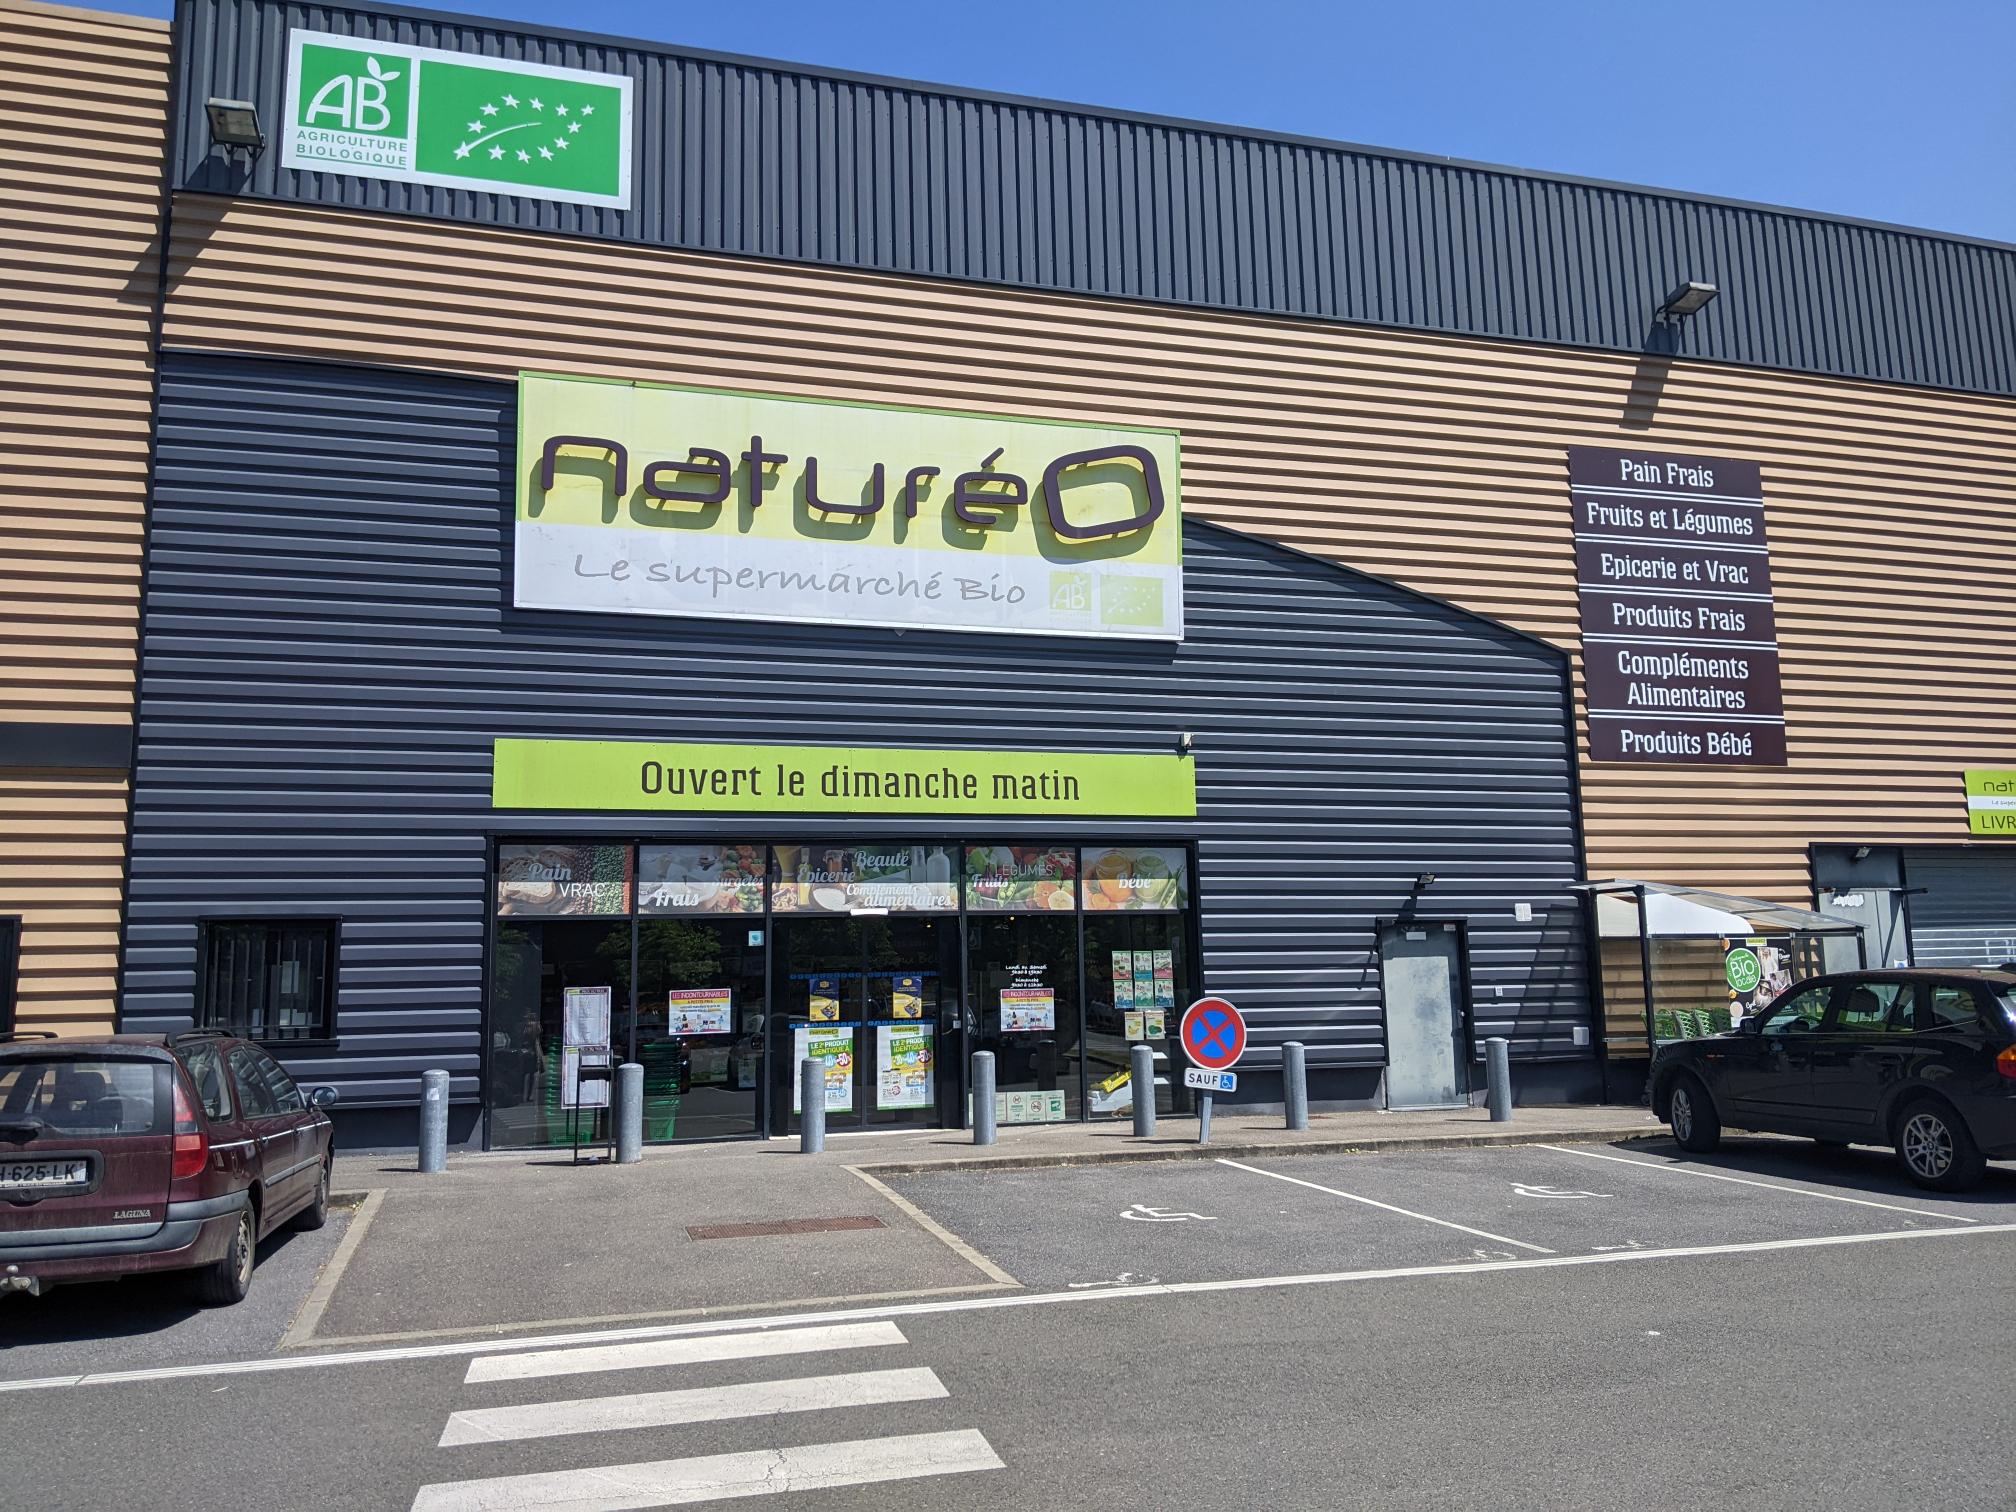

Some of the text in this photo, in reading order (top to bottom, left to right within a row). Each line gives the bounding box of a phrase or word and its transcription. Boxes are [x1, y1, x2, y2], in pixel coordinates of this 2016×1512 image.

[305, 74, 391, 131] AB
[296, 143, 407, 166] BIOLOGIQUE
[297, 130, 408, 152] AGRICULTURE
[1620, 458, 1714, 488] Pain Frais
[541, 435, 1165, 540] naturéO
[1587, 501, 1753, 536] Fruits et Légumes
[574, 554, 1026, 604] Le supermarché Bio
[1601, 552, 1749, 584] Epicerie et Vrac
[1612, 603, 1746, 632] Produits Frais
[1618, 650, 1749, 680] Compléments
[1627, 682, 1746, 709] Alimentaires
[1620, 729, 1753, 756] Produits Bébé
[641, 760, 1080, 801] Ouvert le dimanche matin
[528, 862, 572, 881] Pain
[854, 850, 909, 867] Beauté
[560, 882, 607, 898] VRAC
[972, 873, 1009, 888] Fruits
[1117, 872, 1152, 889] Bébé
[655, 887, 700, 907] Frais
[1189, 1073, 1218, 1085] SAUF
[113, 1209, 151, 1219] LAGUNA
